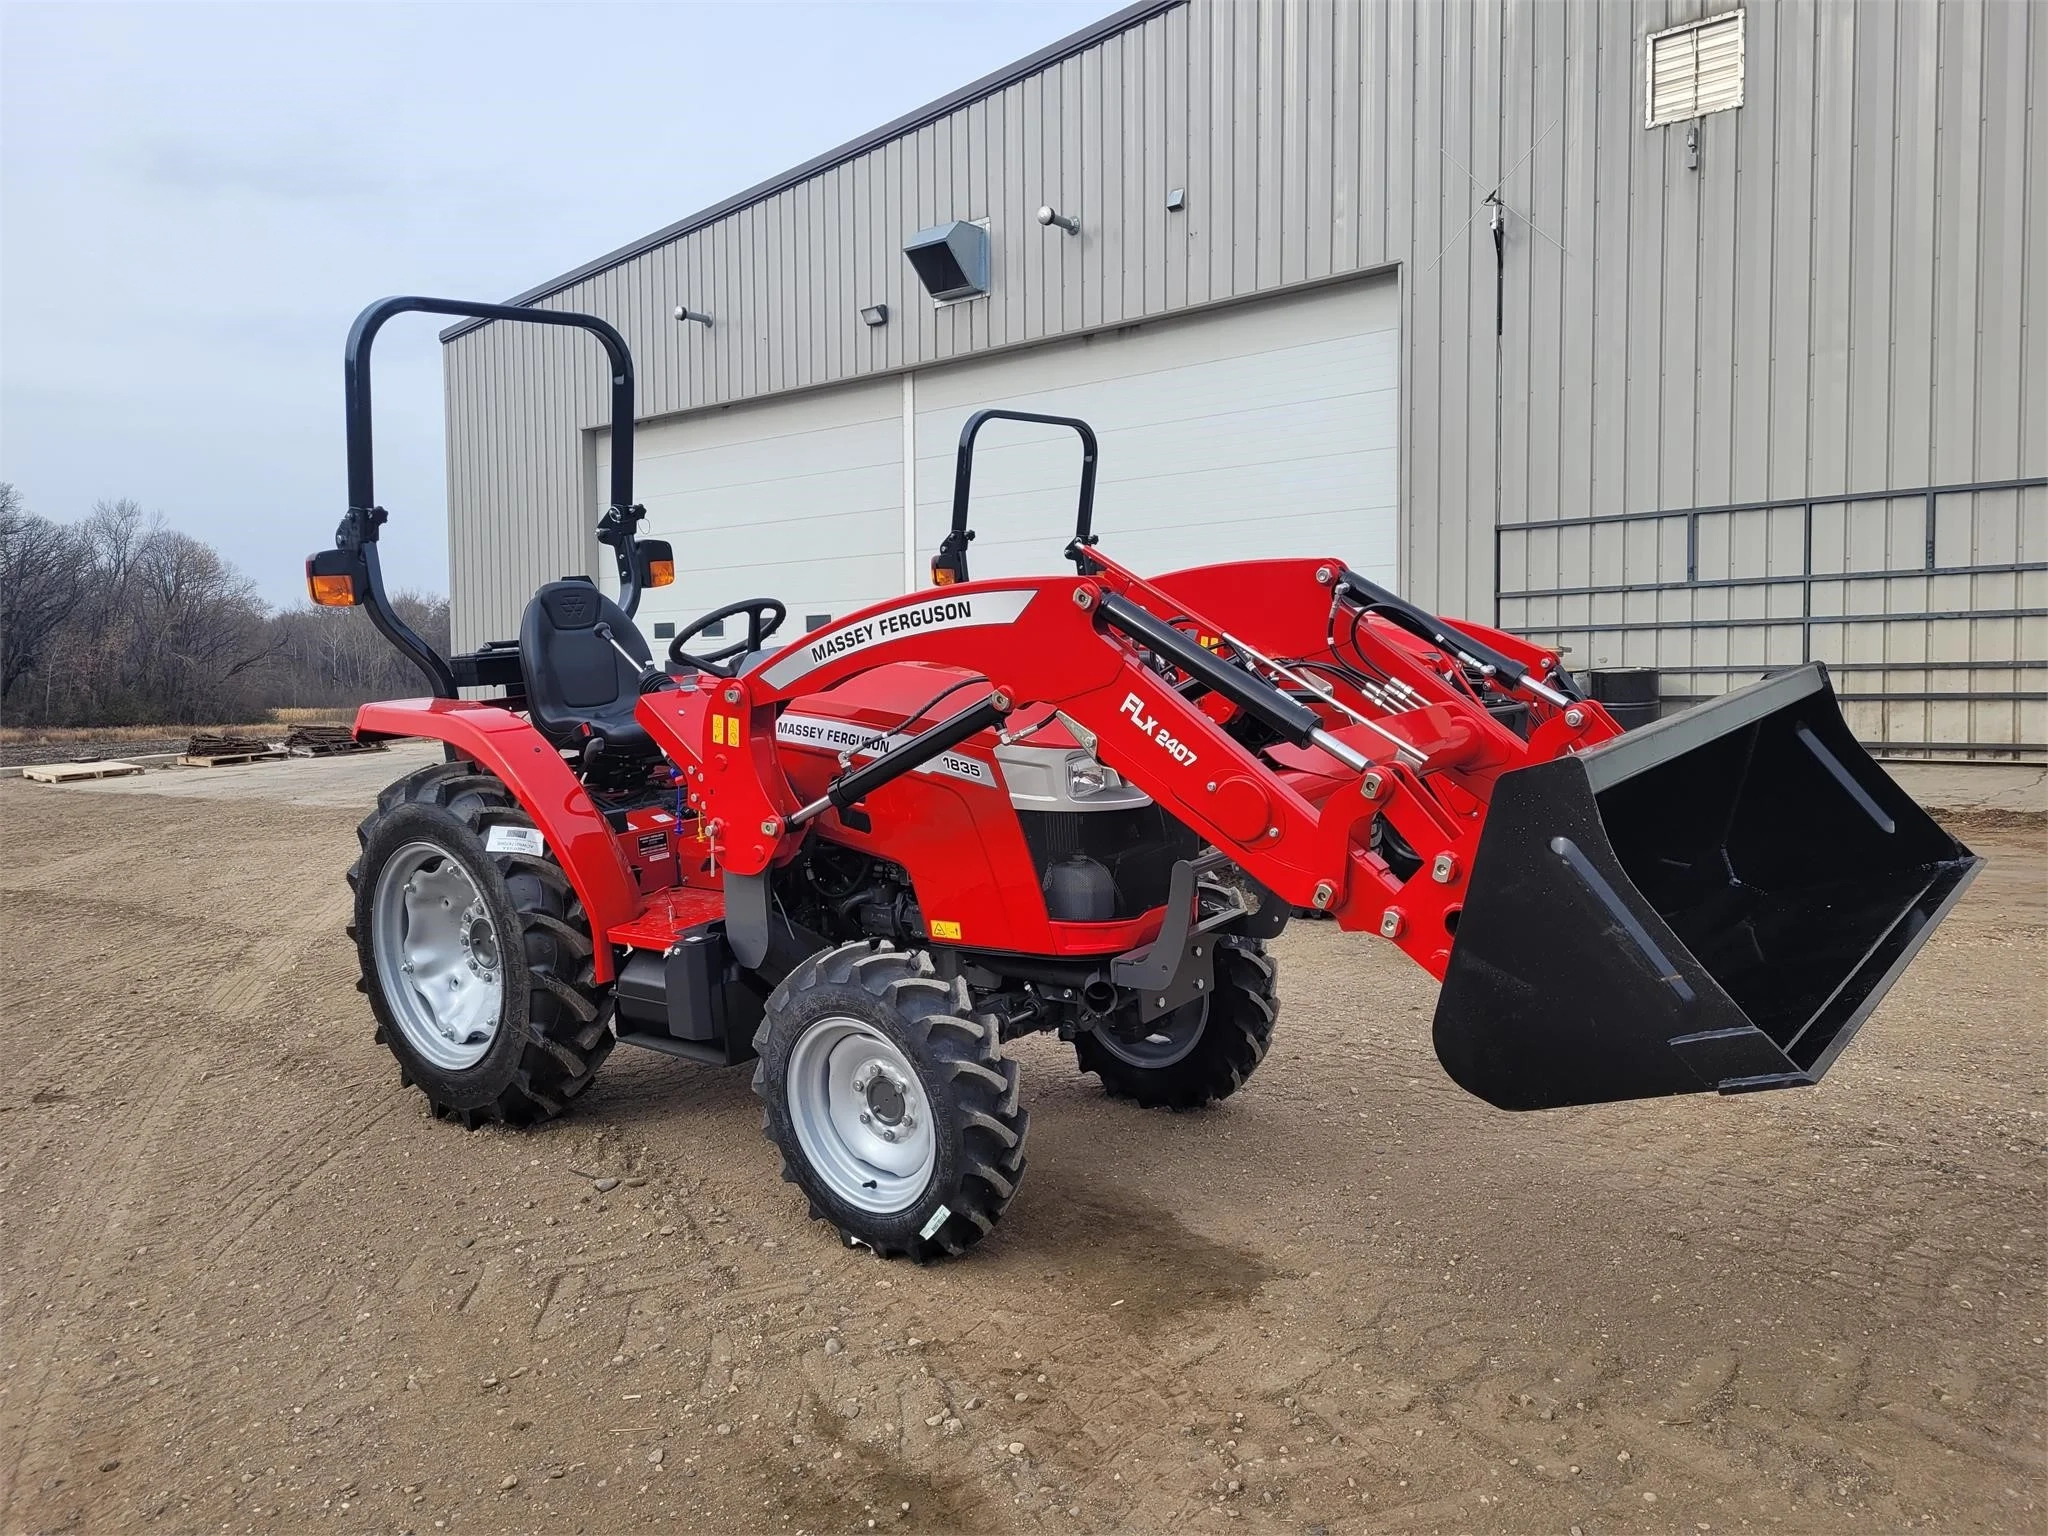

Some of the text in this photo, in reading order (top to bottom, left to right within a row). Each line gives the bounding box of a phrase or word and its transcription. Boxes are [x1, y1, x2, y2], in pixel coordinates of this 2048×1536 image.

[811, 601, 971, 663] MASSEY FERGUSON
[777, 722, 824, 739] MASSEY
[1155, 729, 1198, 767] 2407
[943, 757, 980, 776] 1835
